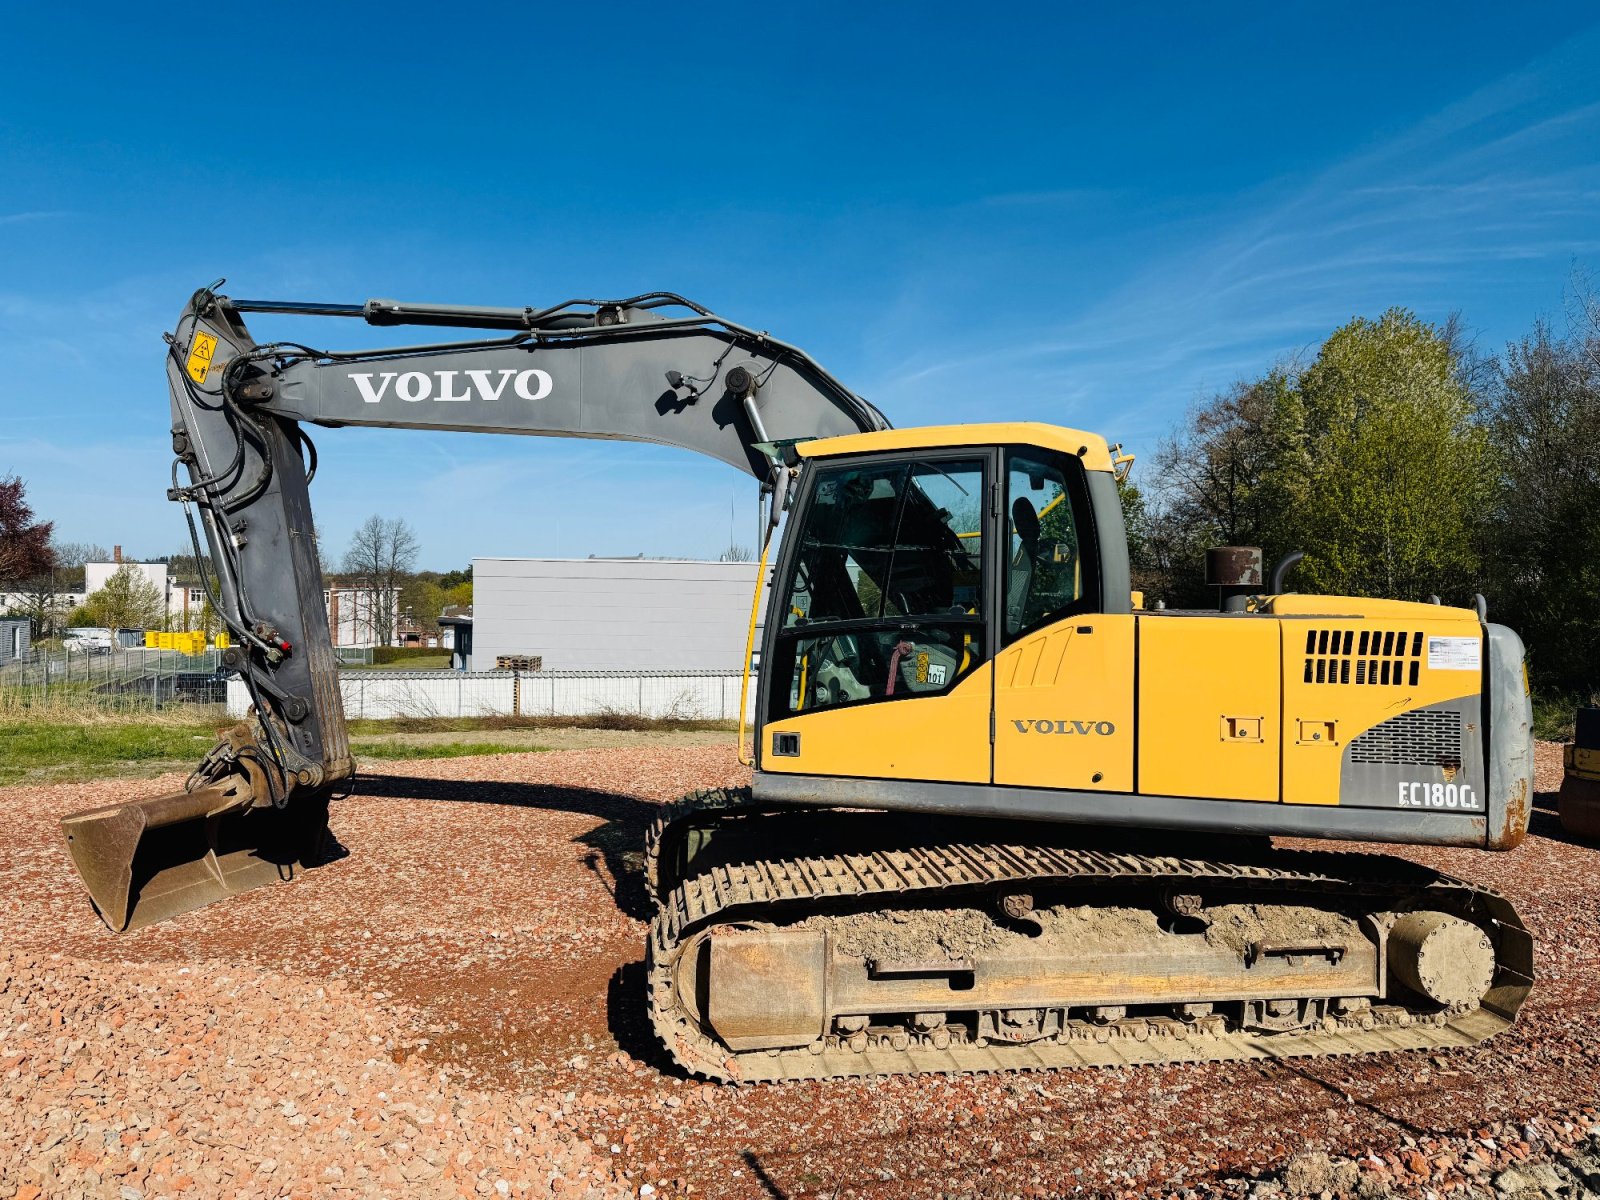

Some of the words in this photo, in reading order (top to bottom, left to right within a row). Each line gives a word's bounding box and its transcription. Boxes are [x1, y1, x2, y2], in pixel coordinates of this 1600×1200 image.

[348, 369, 553, 403] VOLVO
[928, 673, 942, 683] 101
[1011, 719, 1115, 736] VOLVO
